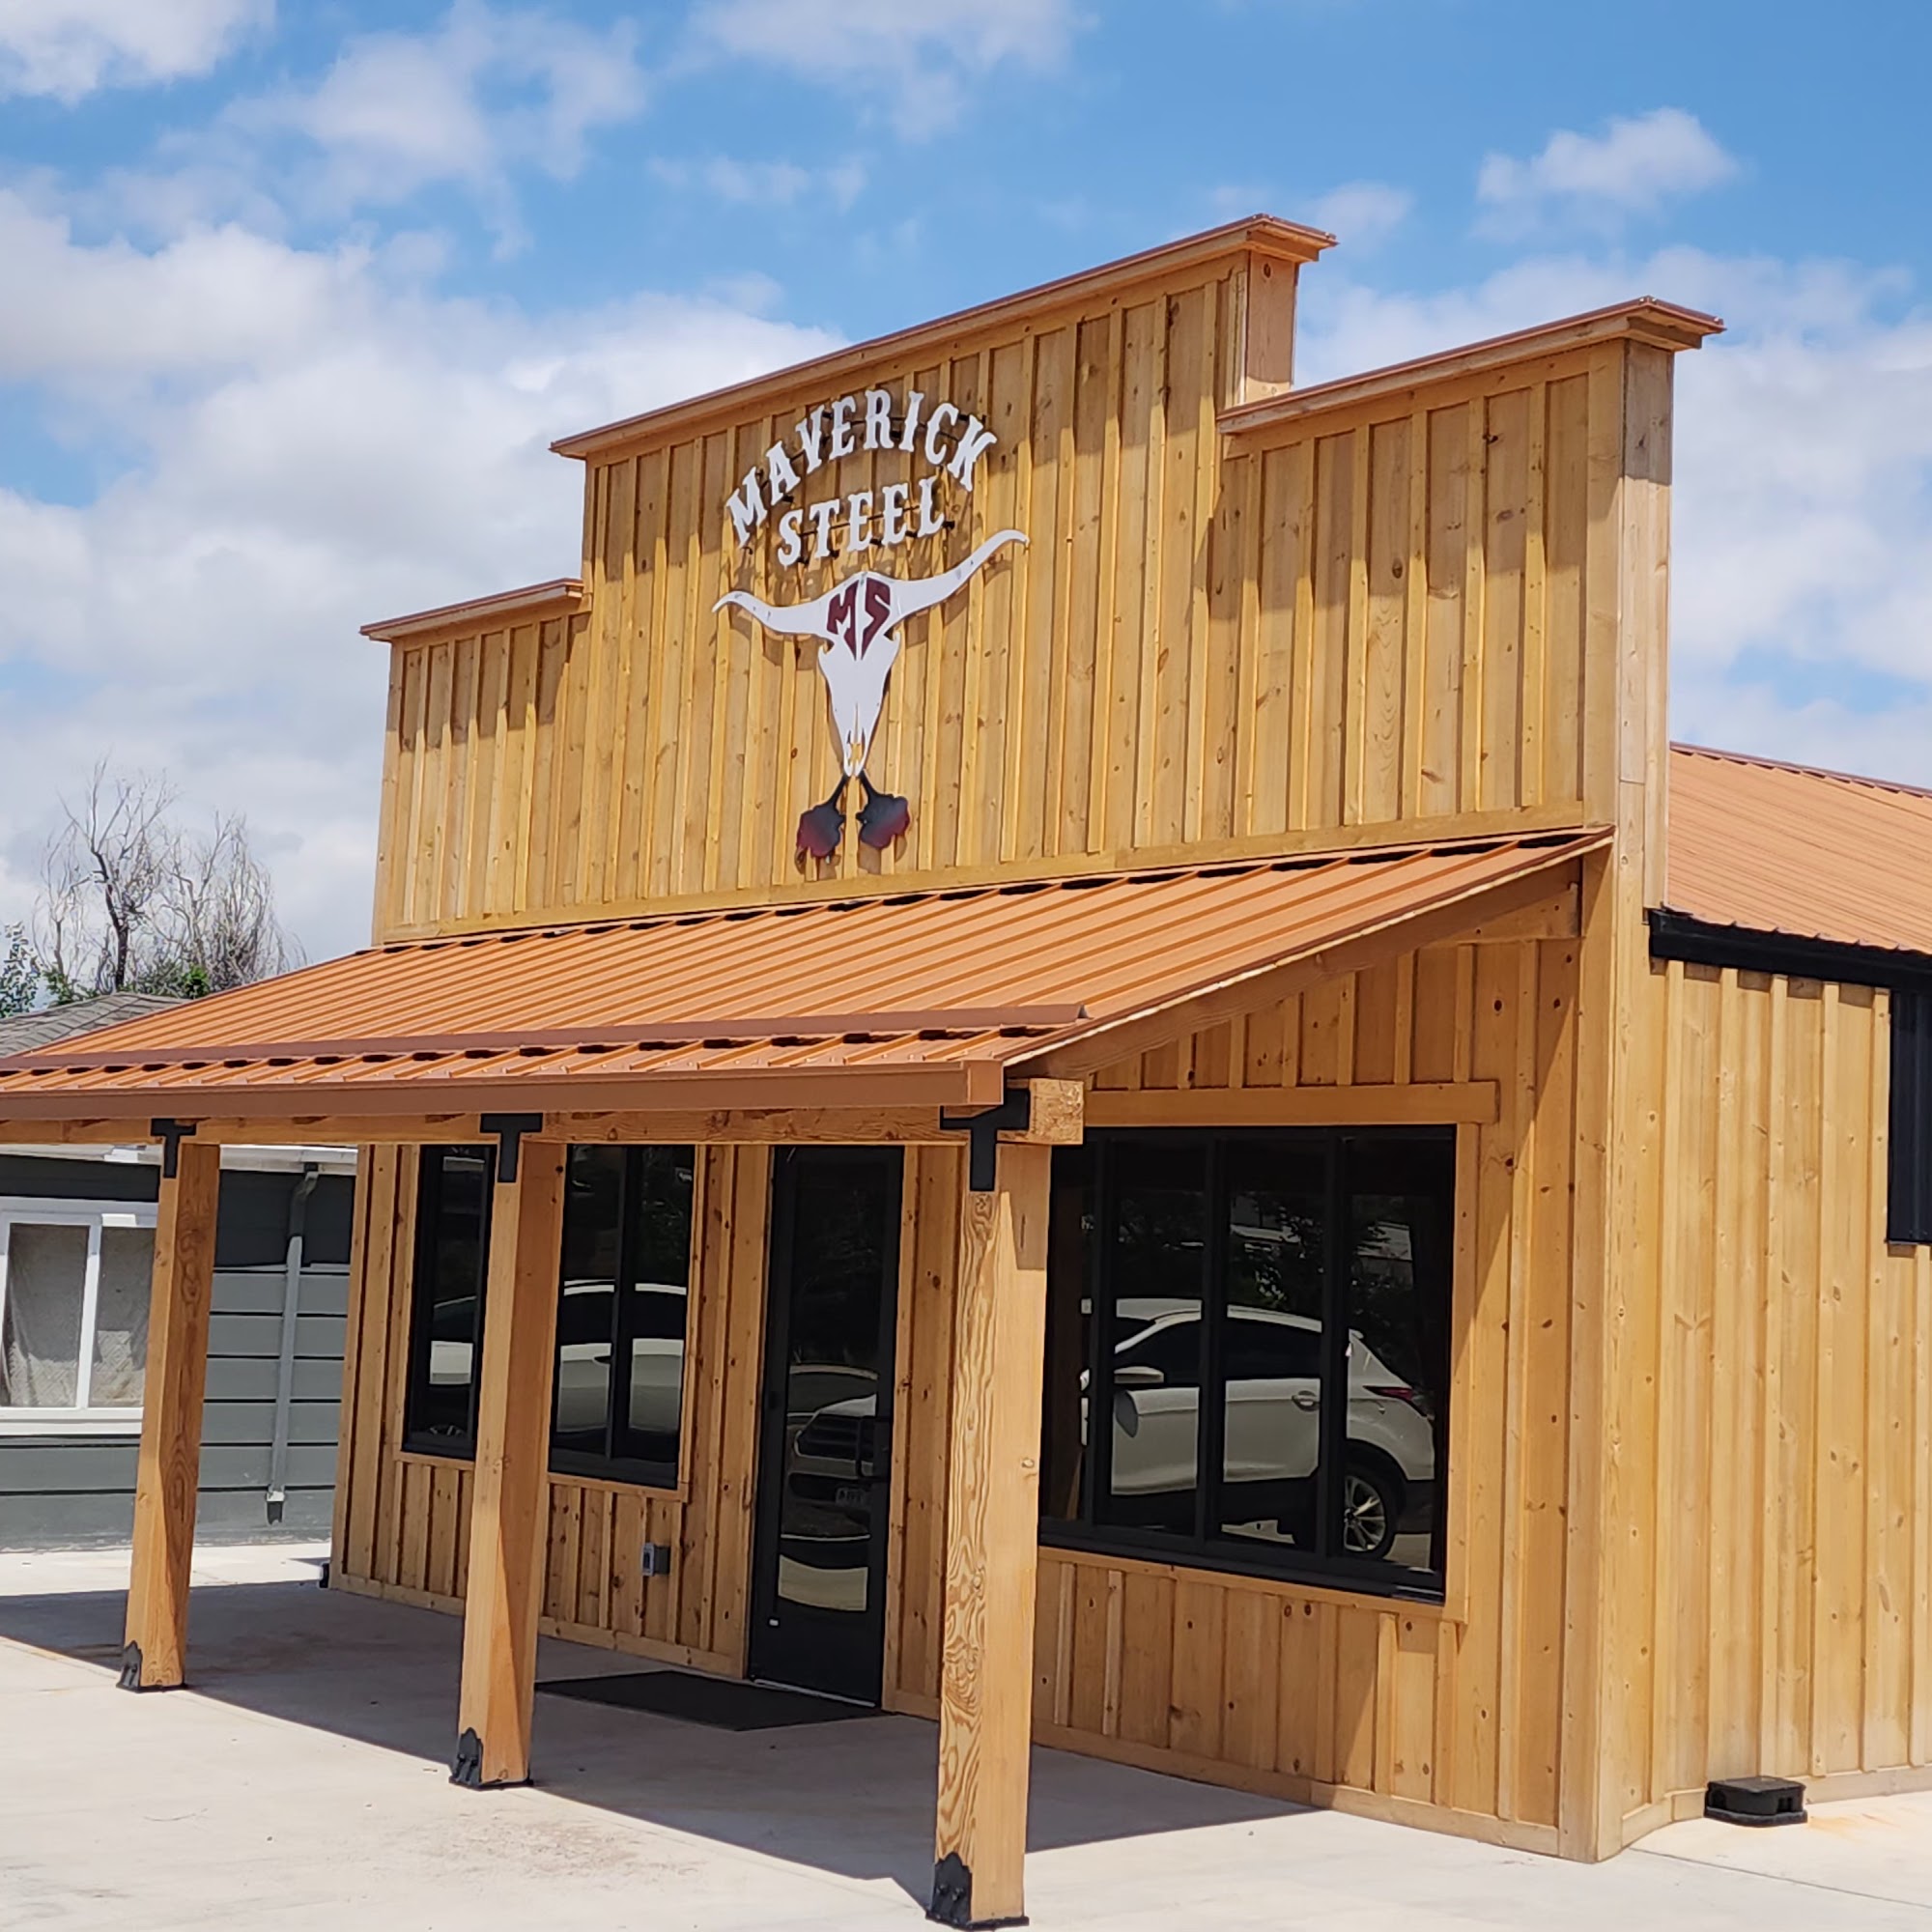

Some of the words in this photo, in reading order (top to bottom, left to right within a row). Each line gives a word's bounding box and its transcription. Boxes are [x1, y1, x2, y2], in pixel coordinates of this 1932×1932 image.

[726, 389, 997, 548] MAVERICK
[777, 477, 945, 566] STEEL
[826, 577, 892, 662] MS
